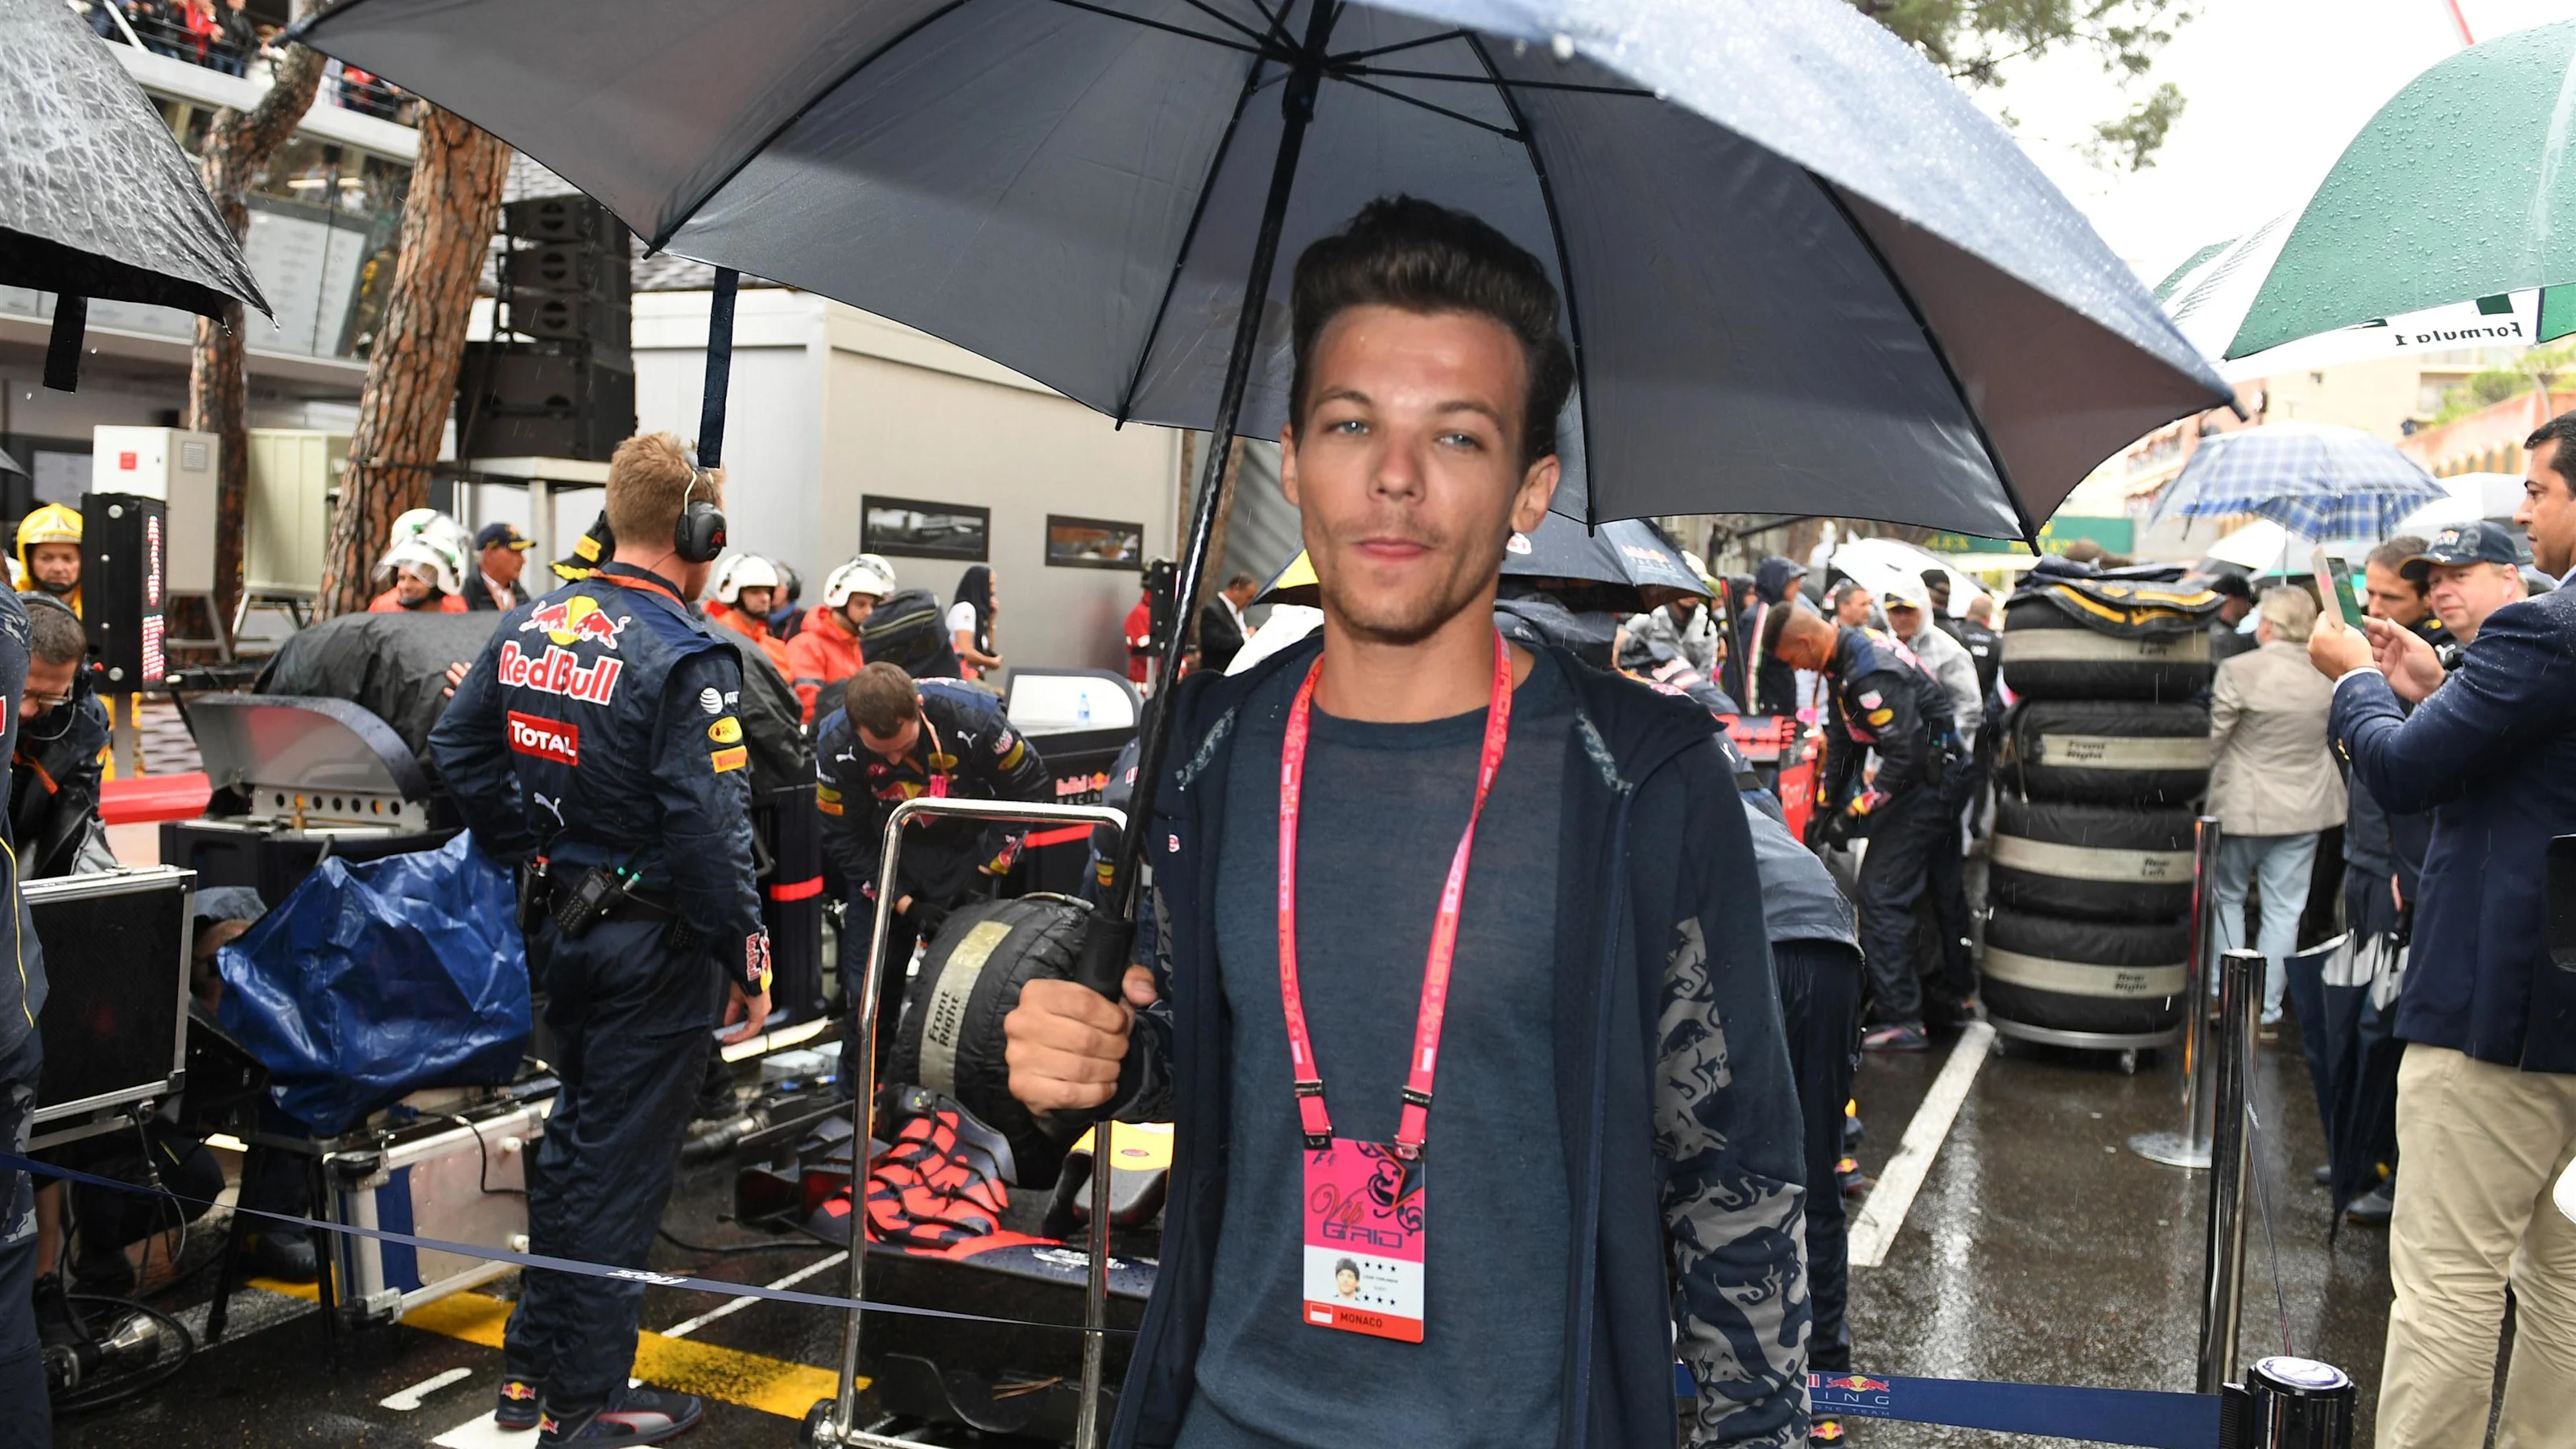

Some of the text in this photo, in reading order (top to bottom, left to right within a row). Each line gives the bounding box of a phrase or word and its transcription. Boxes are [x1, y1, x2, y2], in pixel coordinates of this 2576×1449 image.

[511, 720, 576, 757] TOTAL
[927, 989, 950, 1042] Front
[939, 995, 960, 1046] Right
[1340, 1312, 1383, 1328] MONACO
[1814, 1404, 1890, 1417] ONE TEAM
[1825, 1391, 1890, 1406] ING
